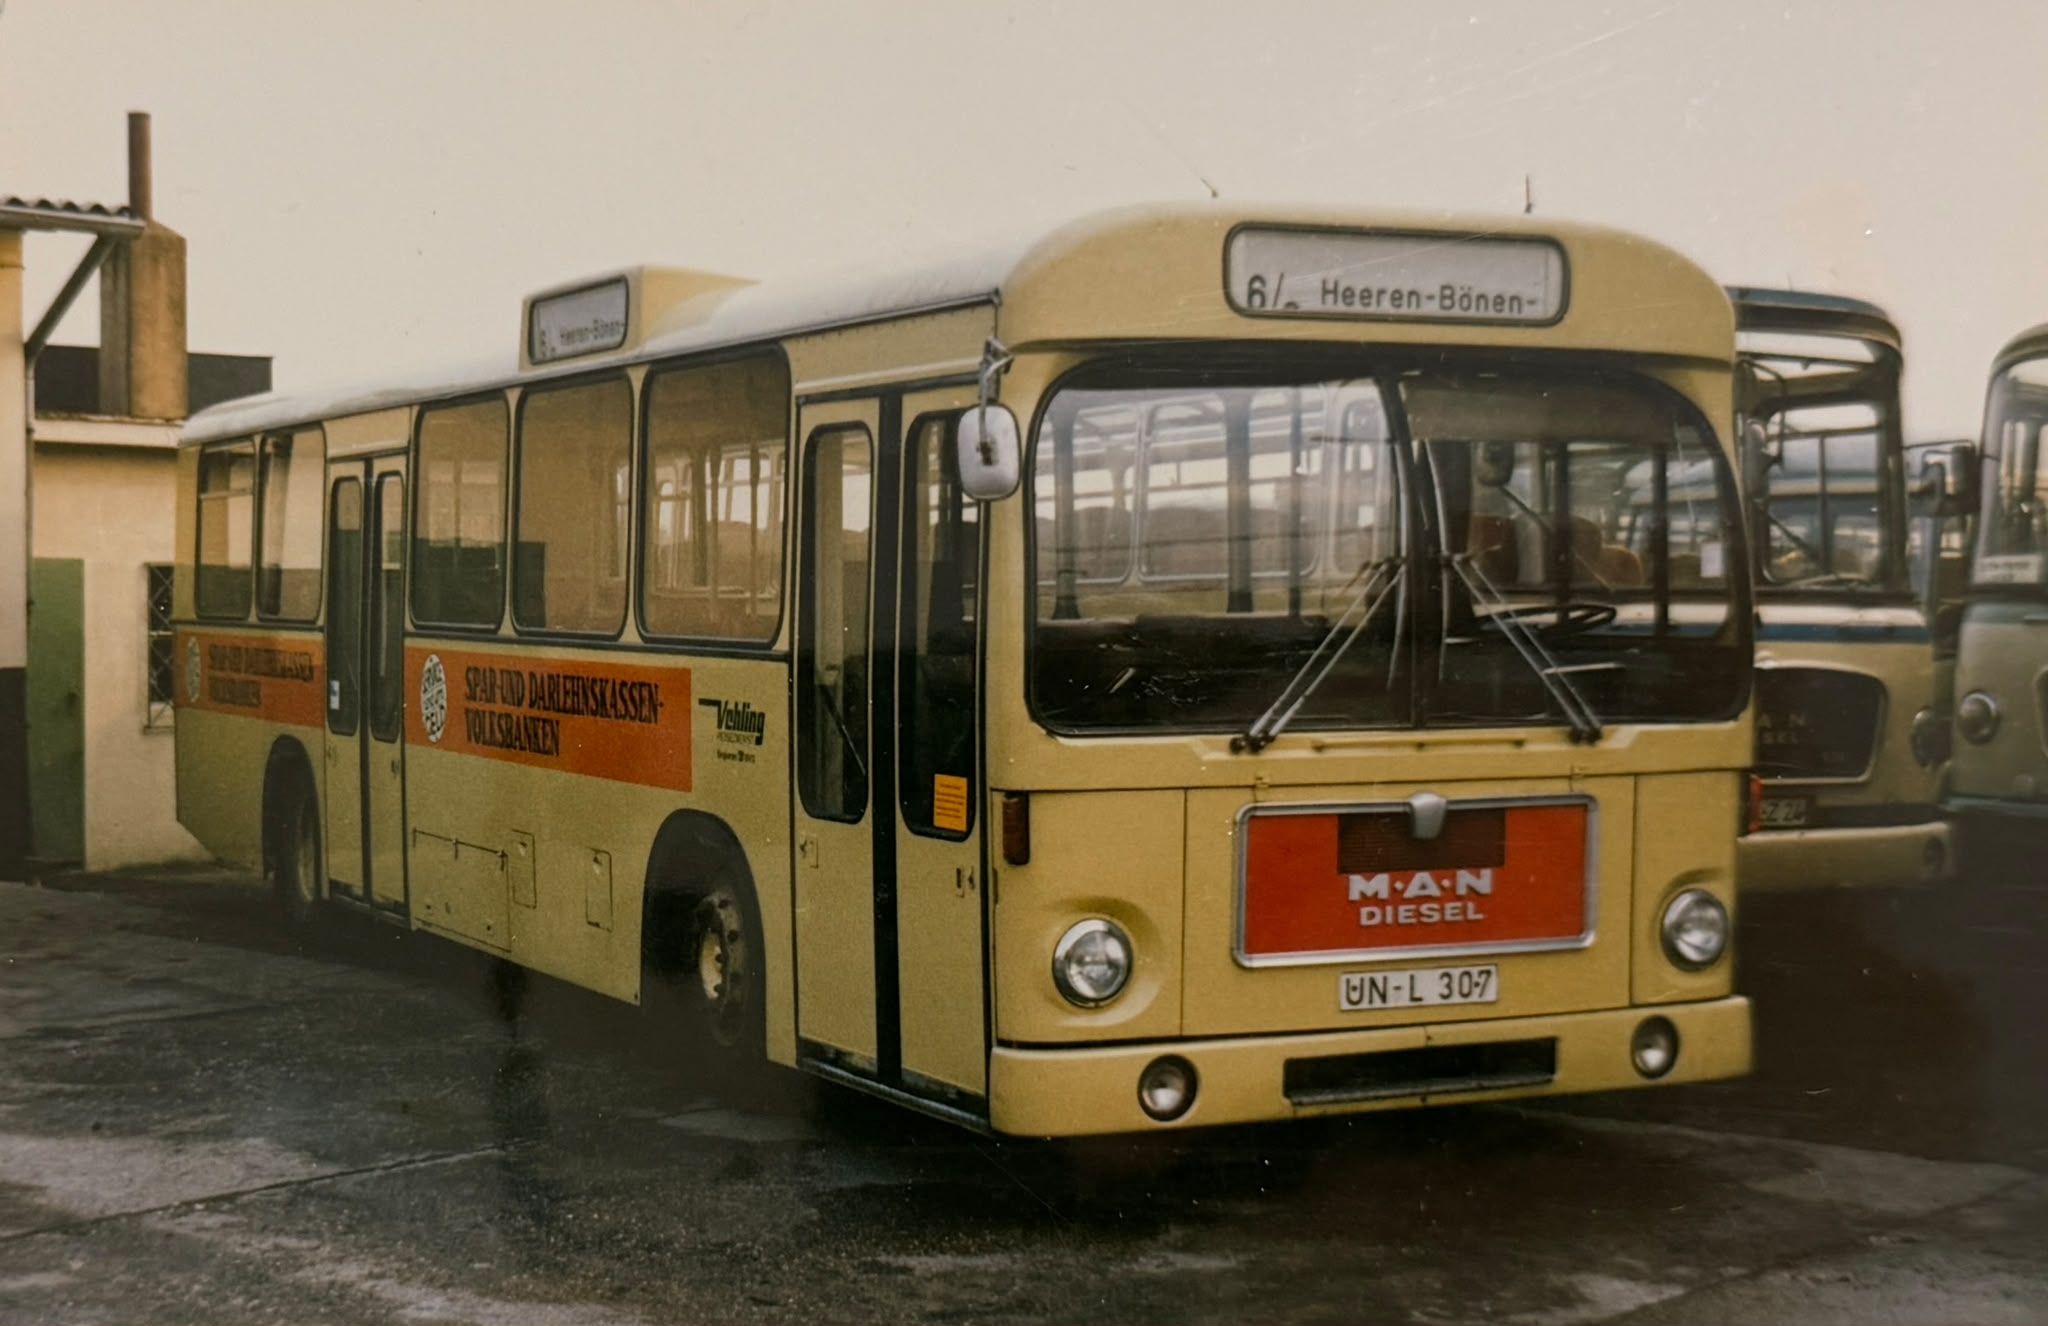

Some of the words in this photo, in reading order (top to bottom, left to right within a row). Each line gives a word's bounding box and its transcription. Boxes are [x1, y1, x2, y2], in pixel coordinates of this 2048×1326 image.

[1320, 278, 1537, 314] Heeren-Bönen-
[464, 707, 560, 756] VOLKSBANKEN
[698, 698, 766, 746] Vehling
[1359, 902, 1485, 926] DIESEL
[1438, 969, 1493, 1000] 307
